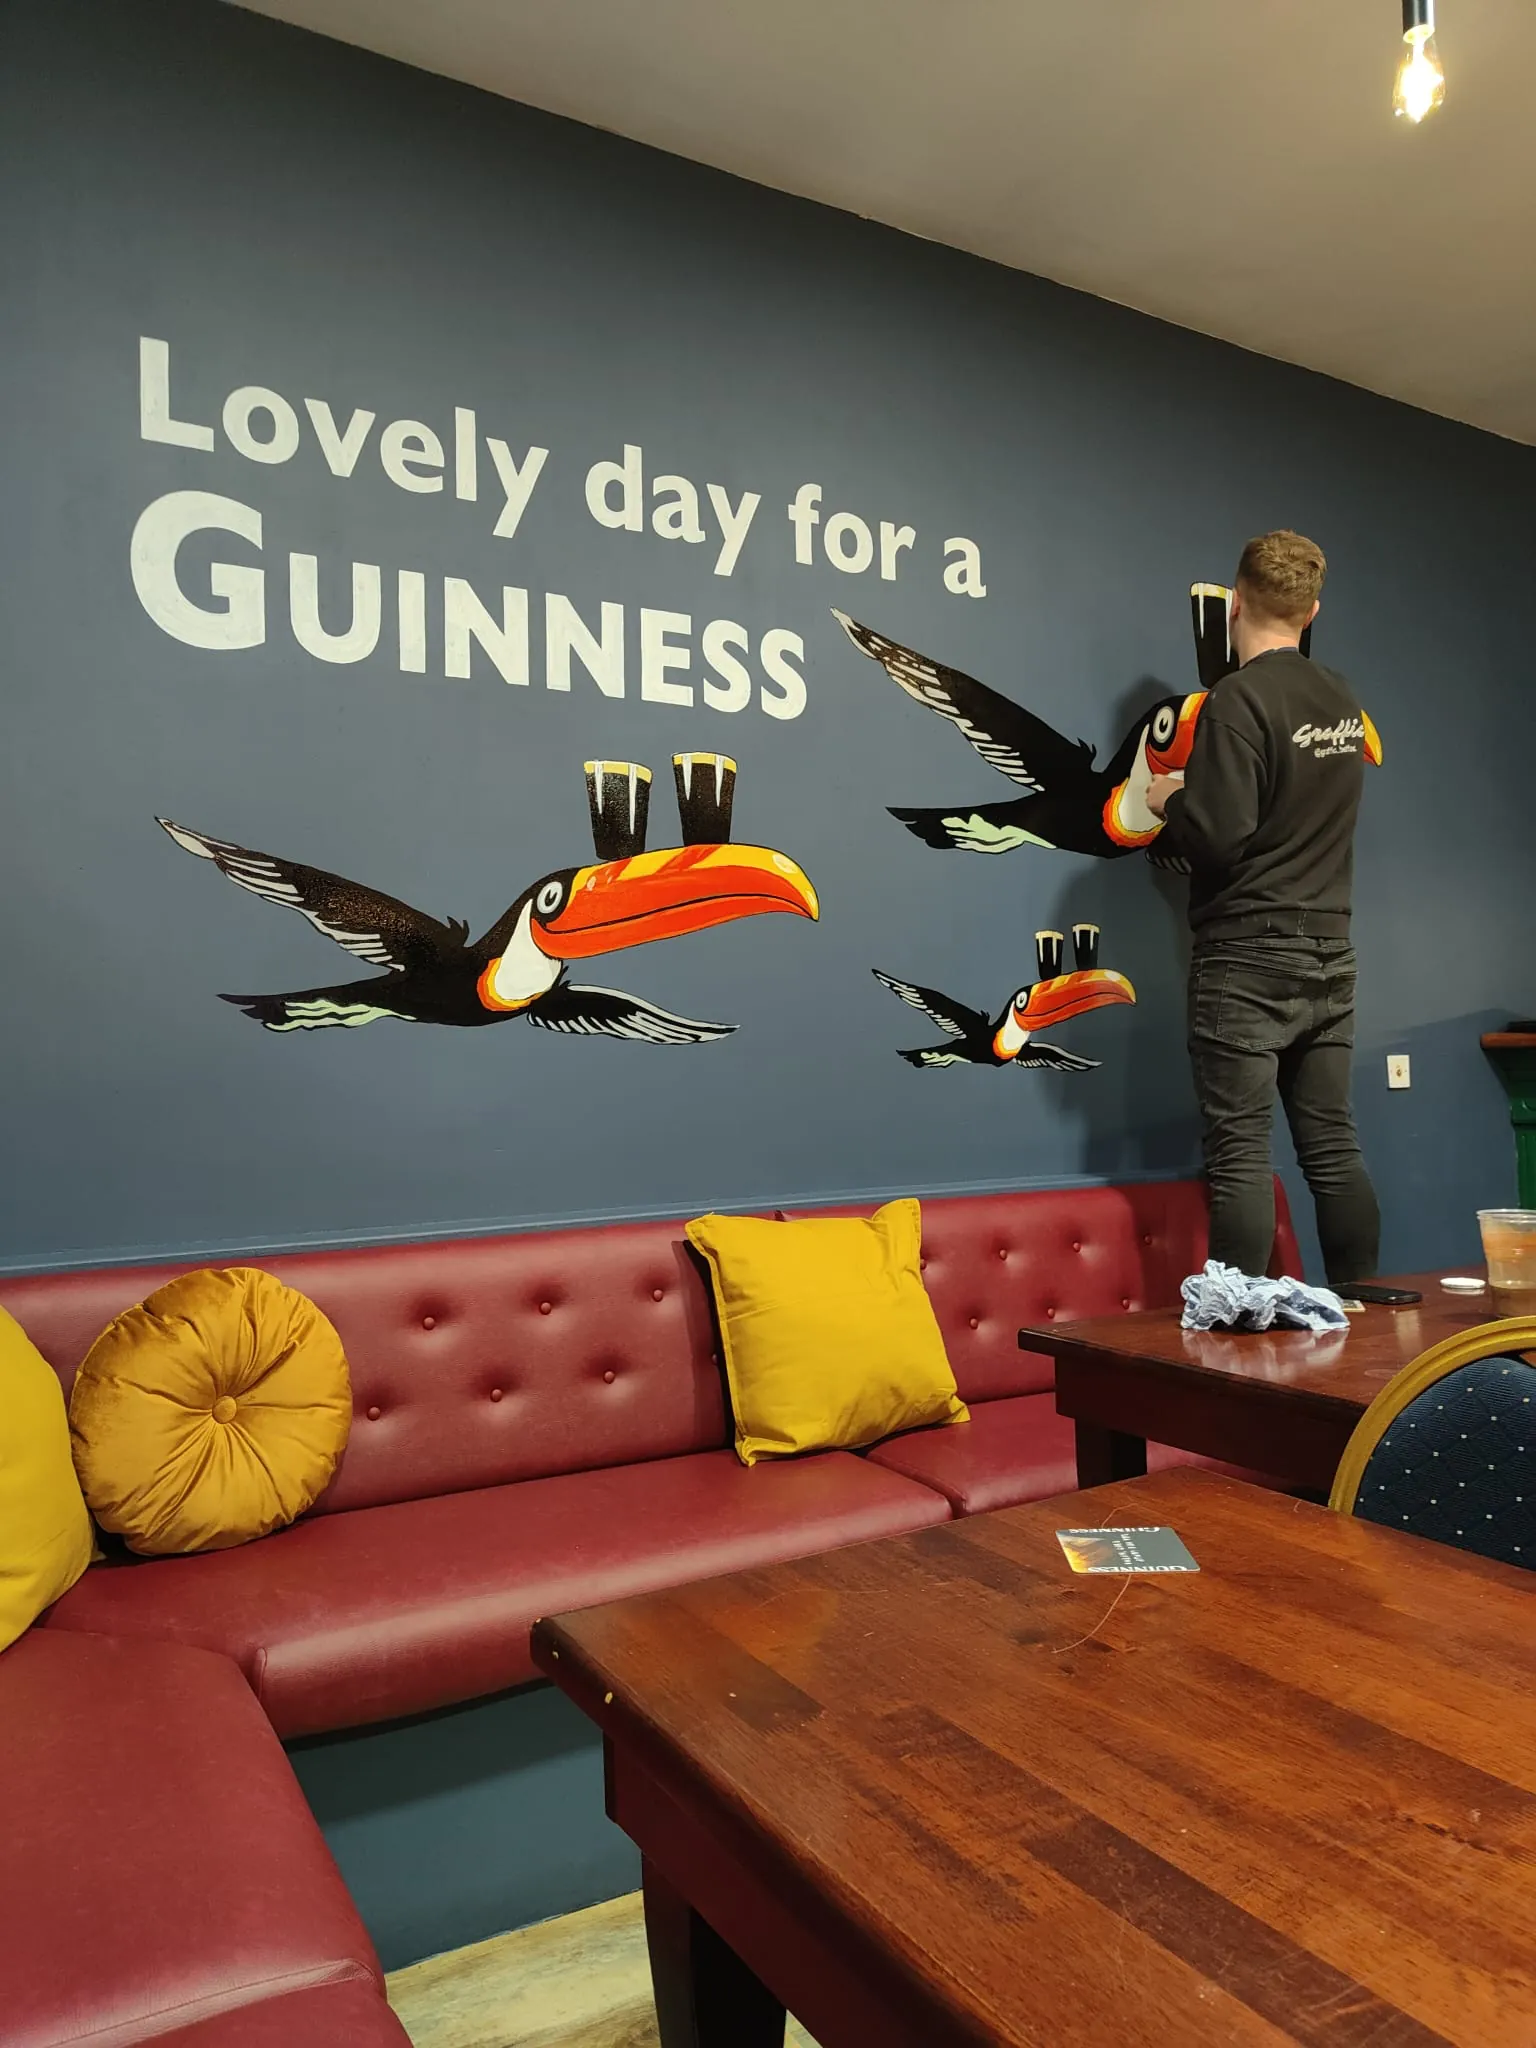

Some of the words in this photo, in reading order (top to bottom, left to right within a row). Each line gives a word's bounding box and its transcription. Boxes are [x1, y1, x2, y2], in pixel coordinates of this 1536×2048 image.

[139, 336, 550, 539] Lovely
[585, 444, 762, 577] day
[787, 483, 917, 581] for
[943, 537, 987, 598] a
[130, 490, 808, 721] GUINNESS
[1087, 1565, 1188, 1573] GUINNESS
